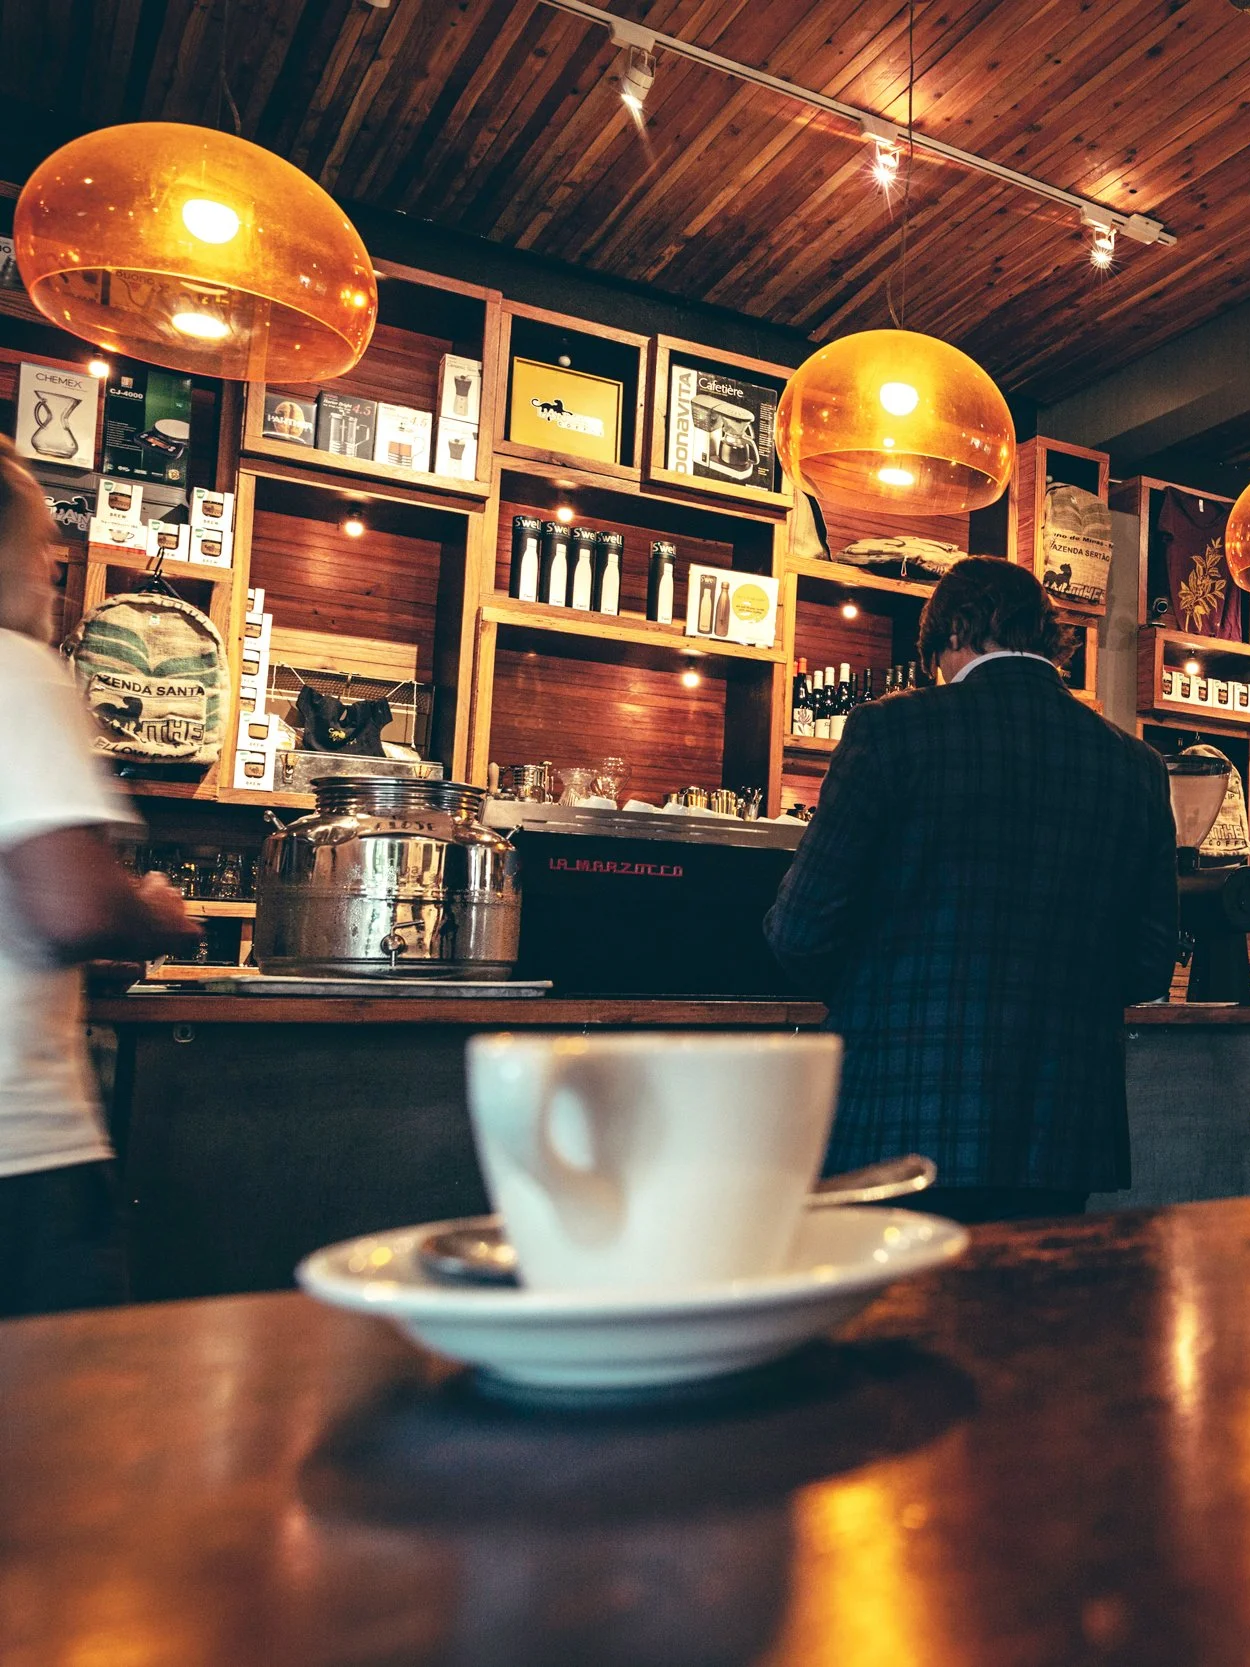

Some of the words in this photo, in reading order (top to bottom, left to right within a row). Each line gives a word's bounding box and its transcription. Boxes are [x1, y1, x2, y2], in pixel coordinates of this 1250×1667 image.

[35, 372, 82, 388] CHEMEX
[109, 388, 144, 399] CJ-4000
[698, 377, 744, 398] Cafetière
[352, 403, 372, 416] 4.5
[155, 686, 205, 697] SANTA
[549, 857, 567, 871] LA
[575, 859, 684, 877] MARZOCCO
